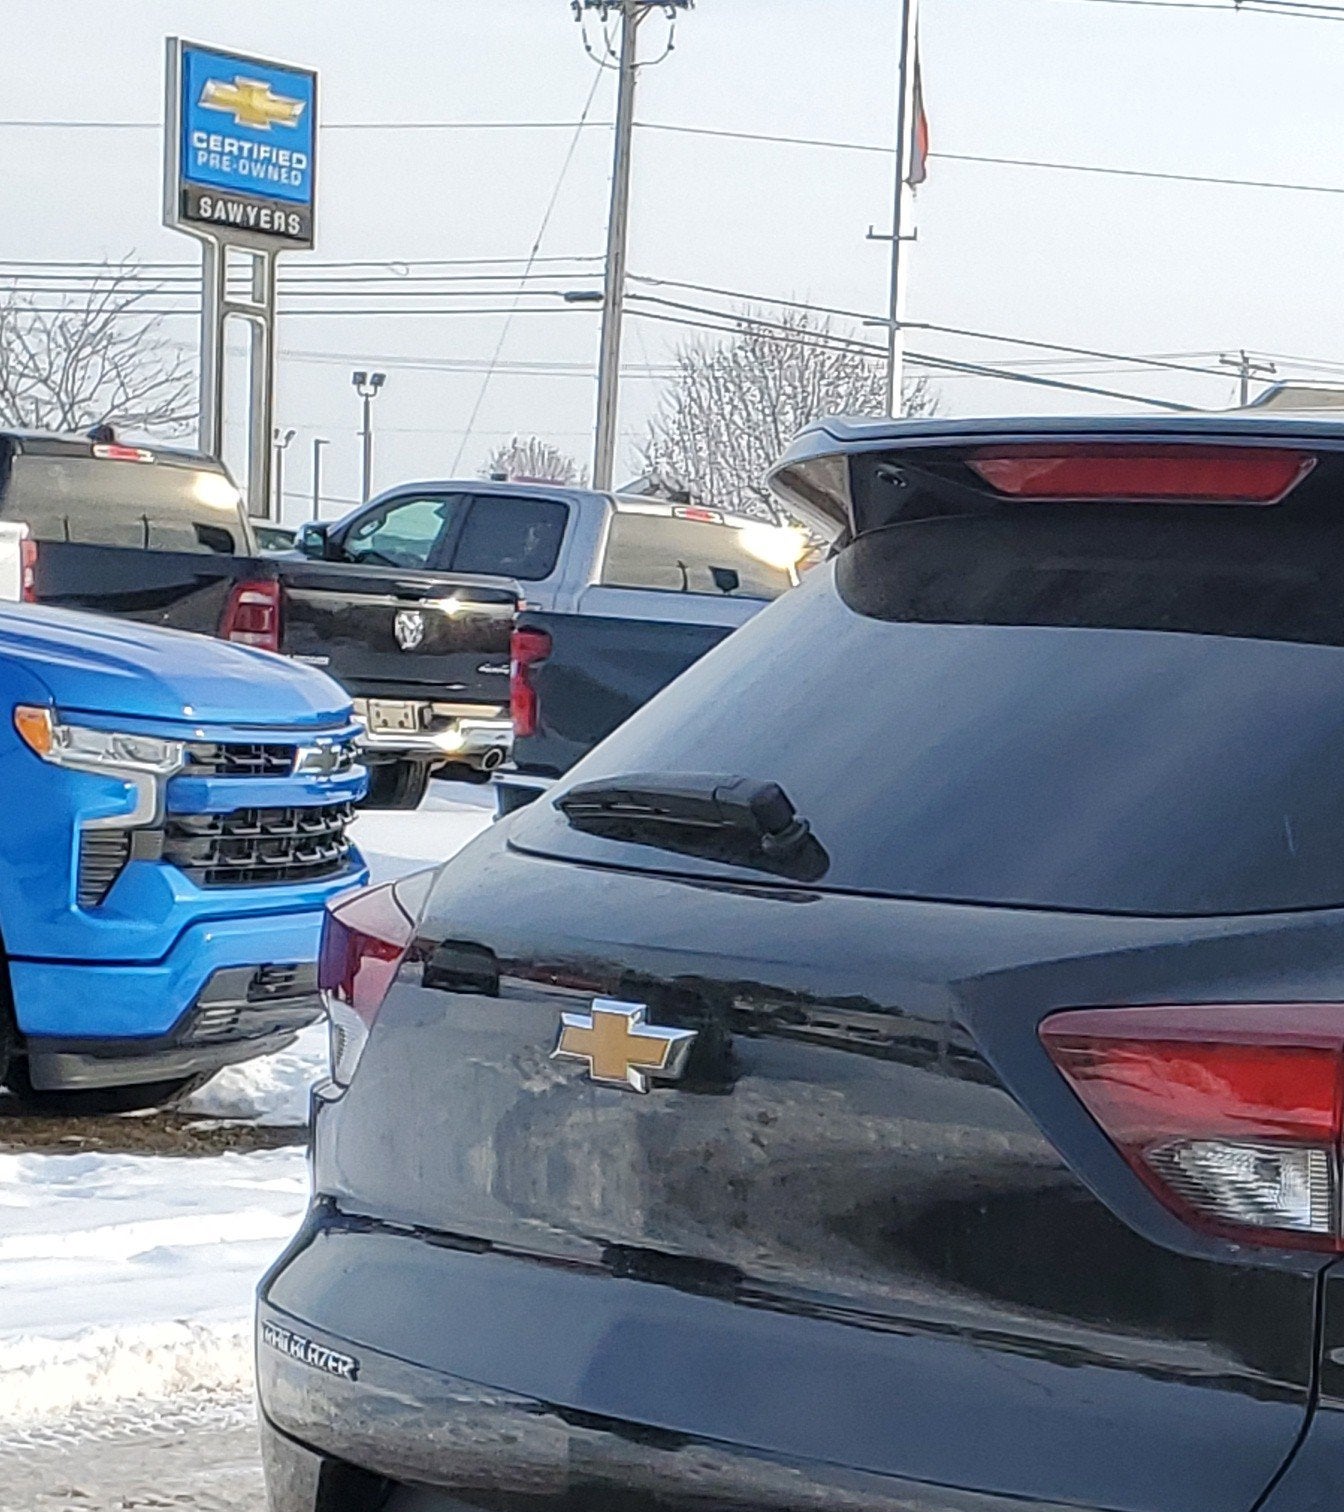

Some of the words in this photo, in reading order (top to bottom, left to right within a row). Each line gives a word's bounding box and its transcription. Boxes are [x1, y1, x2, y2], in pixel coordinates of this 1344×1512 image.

[192, 131, 307, 170] CERTIFIED
[197, 150, 302, 187] PRE-OWNED
[199, 196, 301, 235] SAWYERS
